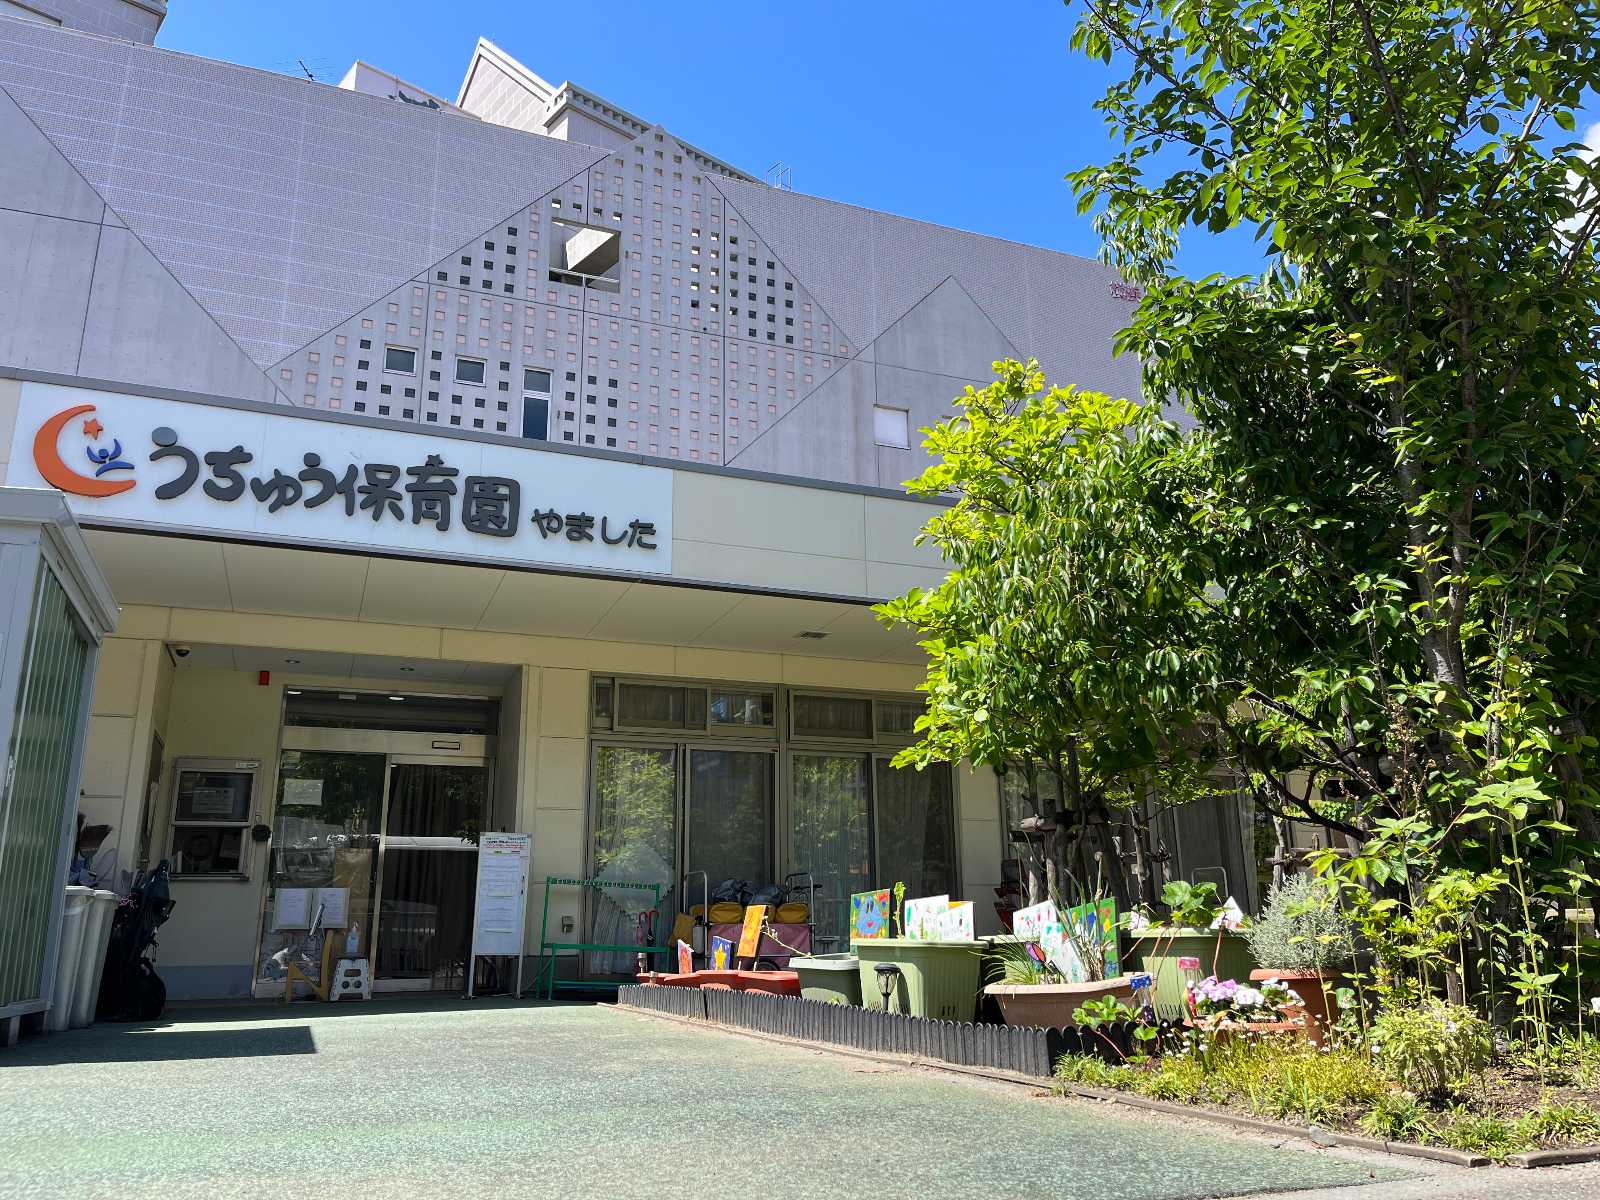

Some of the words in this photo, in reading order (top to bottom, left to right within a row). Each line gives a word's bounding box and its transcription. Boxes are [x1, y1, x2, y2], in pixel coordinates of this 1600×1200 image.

[150, 427, 521, 537] うちゅう保育園
[531, 508, 657, 550] やました
